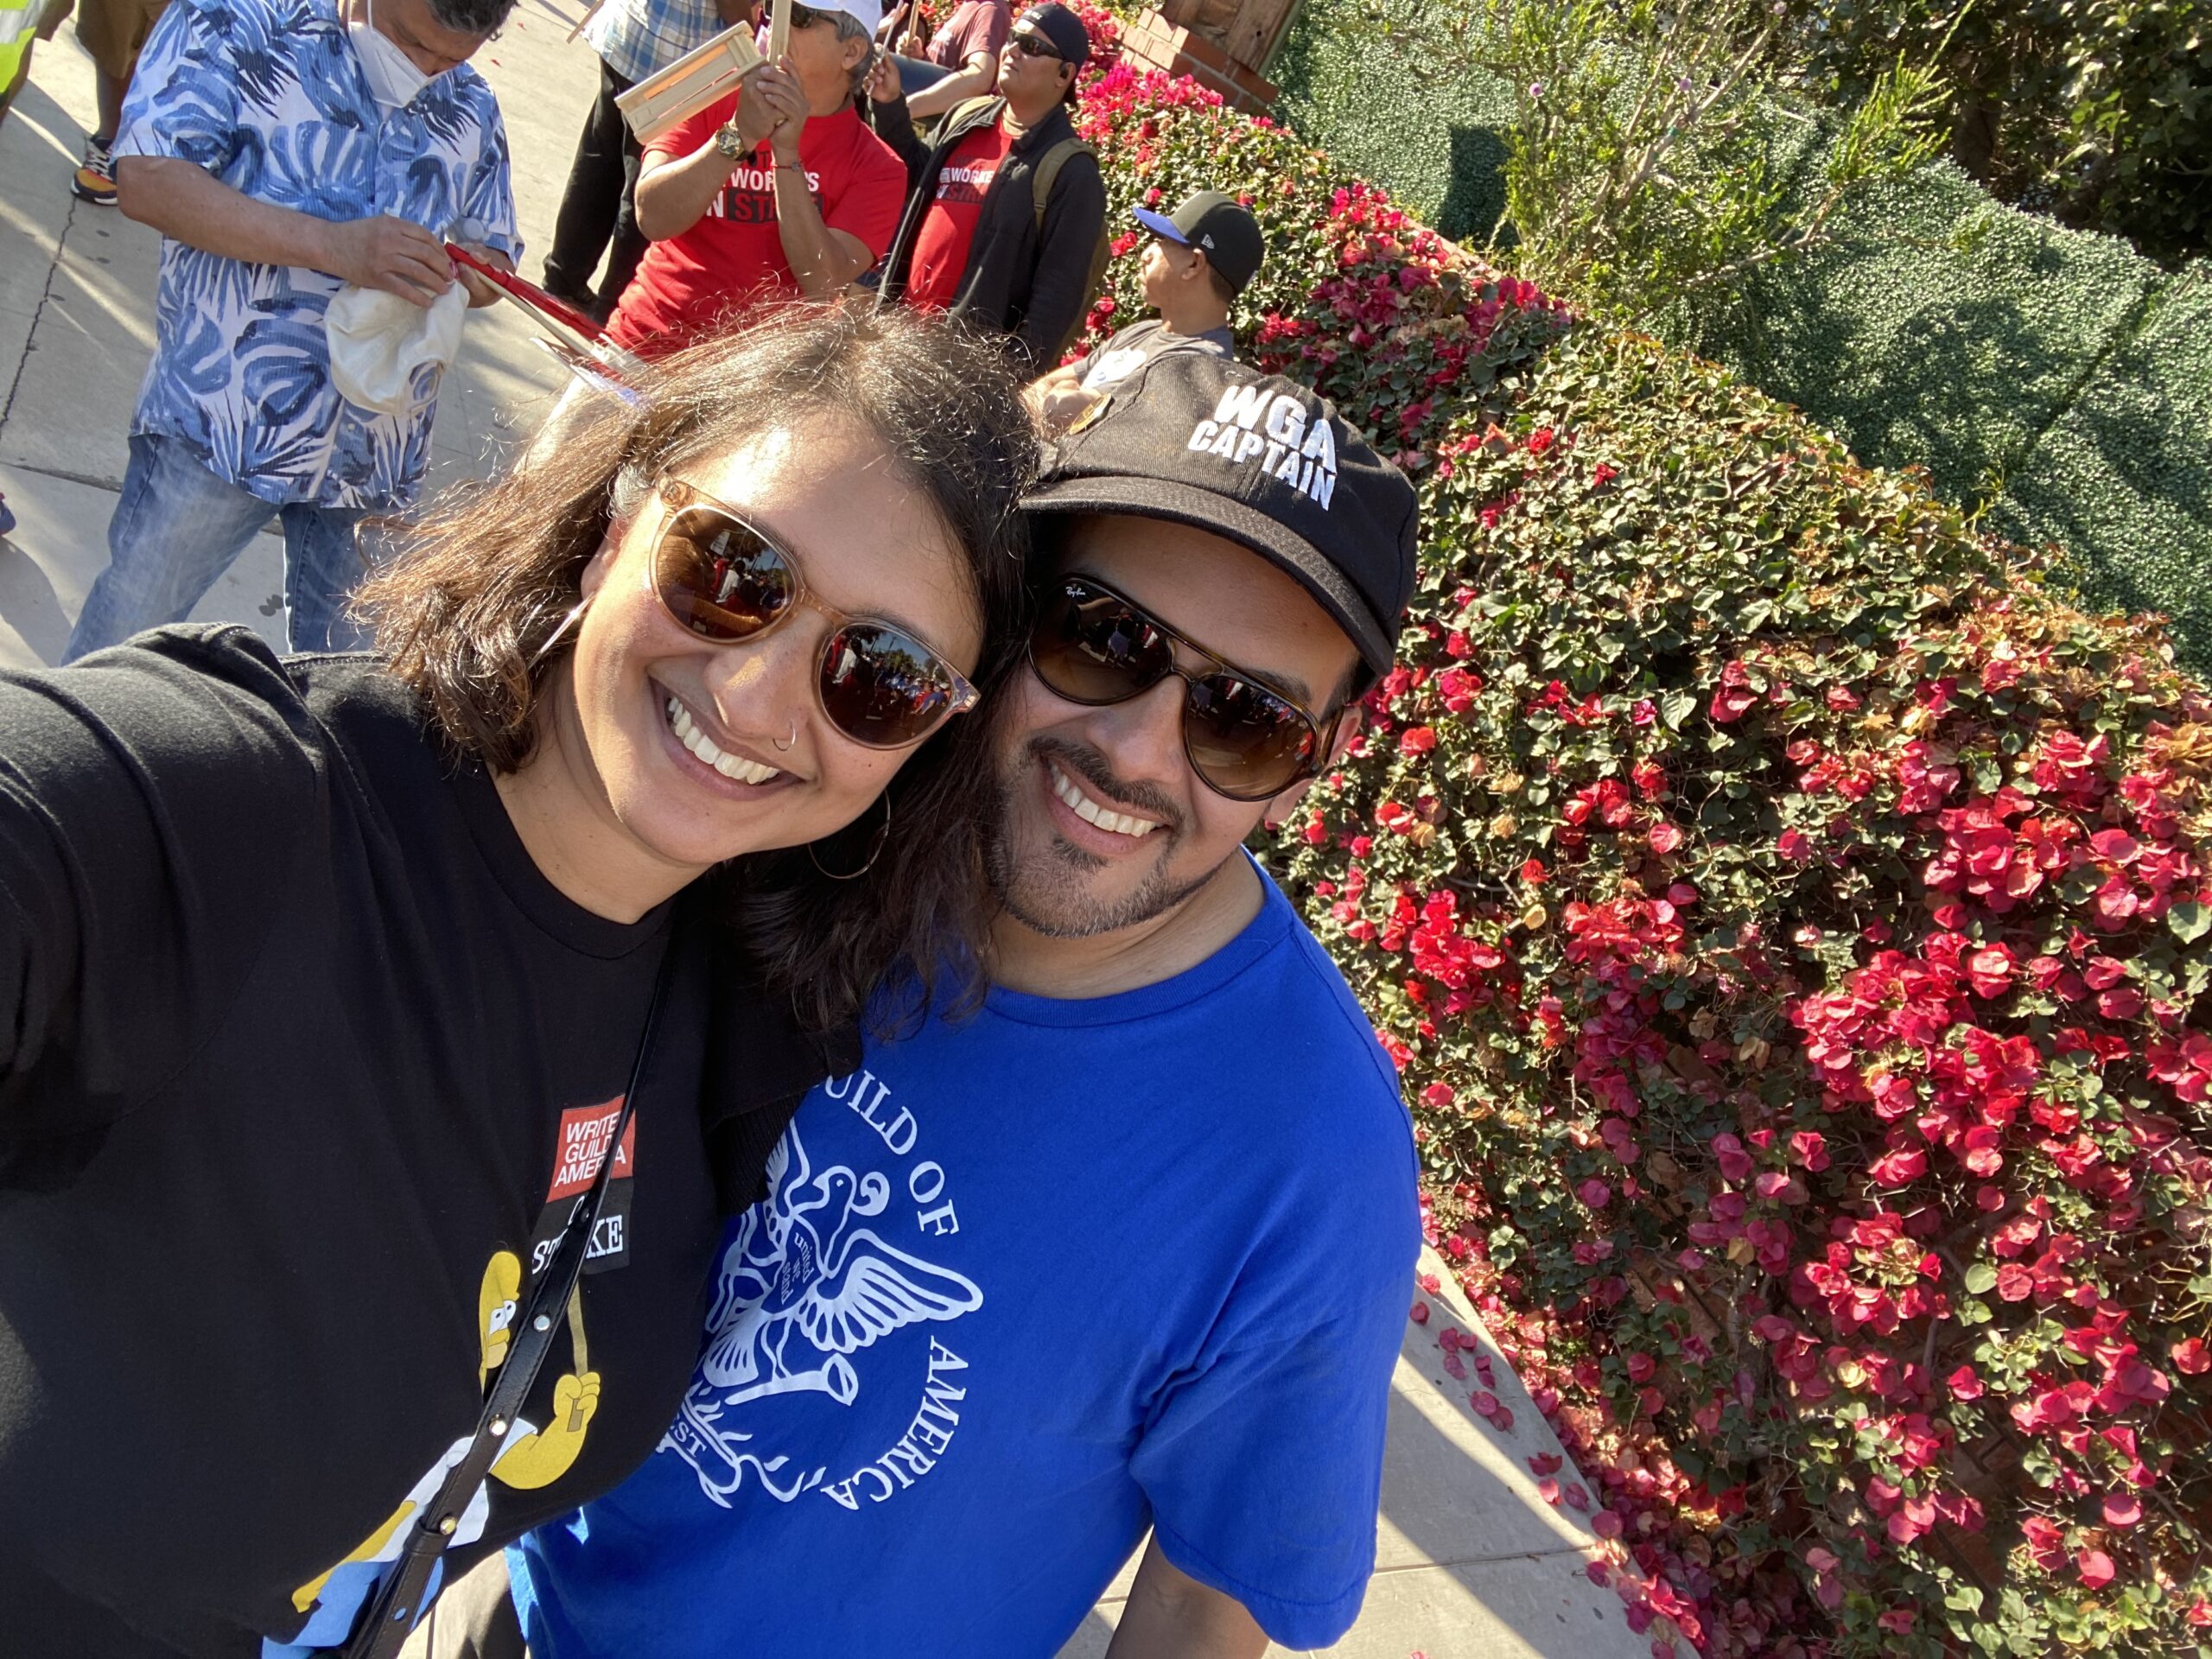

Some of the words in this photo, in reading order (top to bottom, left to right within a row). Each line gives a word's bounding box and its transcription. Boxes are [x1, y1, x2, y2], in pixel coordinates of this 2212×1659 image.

[1188, 420, 1336, 512] CAPTAIN
[1214, 385, 1337, 474] WGA
[566, 1109, 622, 1144] WRITE
[814, 1070, 918, 1155] UILD
[554, 1144, 626, 1180] AMERA
[909, 1160, 959, 1236] OF
[531, 1214, 624, 1274] STKE
[820, 1335, 969, 1510] AMERICA
